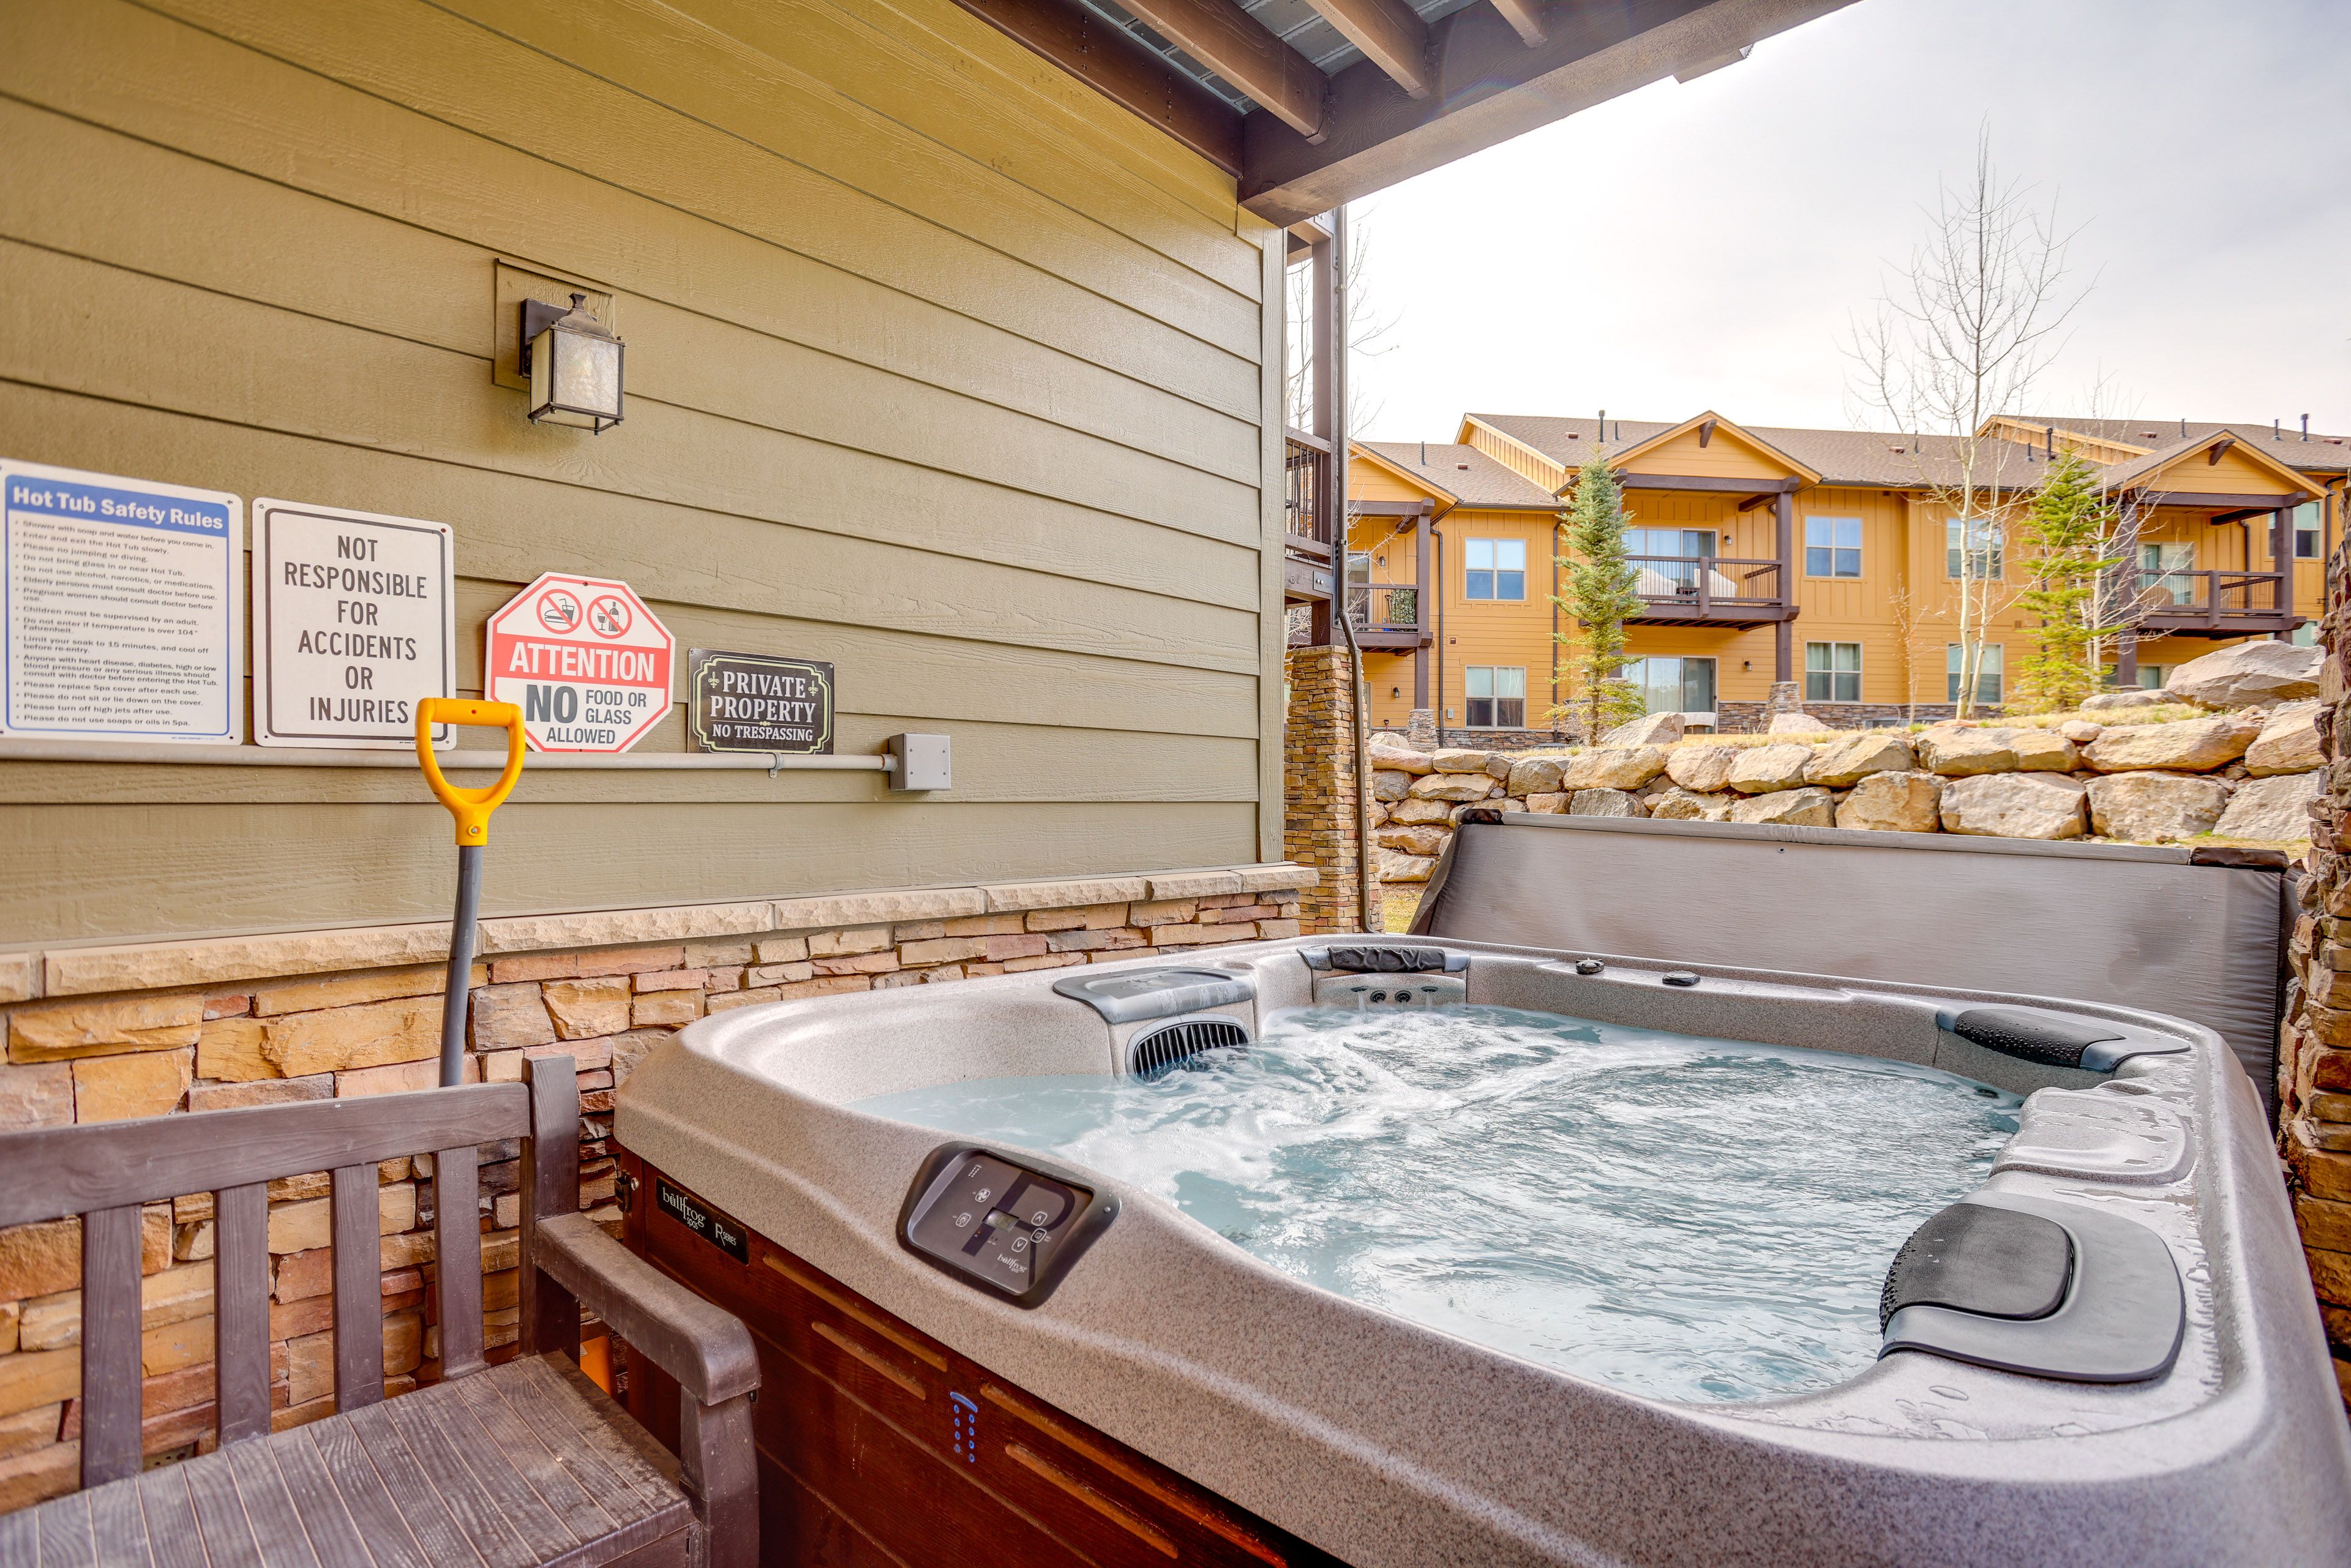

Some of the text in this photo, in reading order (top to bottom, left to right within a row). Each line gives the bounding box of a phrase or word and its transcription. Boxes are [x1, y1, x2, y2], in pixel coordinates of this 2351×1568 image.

[14, 486, 223, 529] Hot Tub Safety Rules
[140, 535, 166, 544] before
[338, 536, 378, 561] NOT
[56, 557, 80, 567] bring
[82, 560, 105, 569] glass
[71, 548, 108, 559] jumping
[55, 580, 90, 588] persons
[285, 562, 427, 598] RESPONSIBLE
[100, 595, 128, 603] should
[103, 613, 149, 622] supervised
[338, 601, 377, 626] FOR
[91, 622, 146, 632] temperature
[298, 630, 416, 660] ACCIDENTS
[509, 641, 656, 681] ATTENTION
[183, 670, 210, 678] should
[346, 666, 372, 689] OR
[722, 671, 806, 698] PRIVATE
[310, 697, 408, 723] INJURIES
[526, 685, 646, 723] NO FOOD OR
[710, 696, 816, 723] PROPERTY
[586, 708, 631, 724] GLASS
[546, 727, 615, 743] ALLOWED
[713, 724, 812, 741] NO TRESPASSING
[662, 1187, 705, 1227] bullfrog
[687, 1217, 698, 1229] spas
